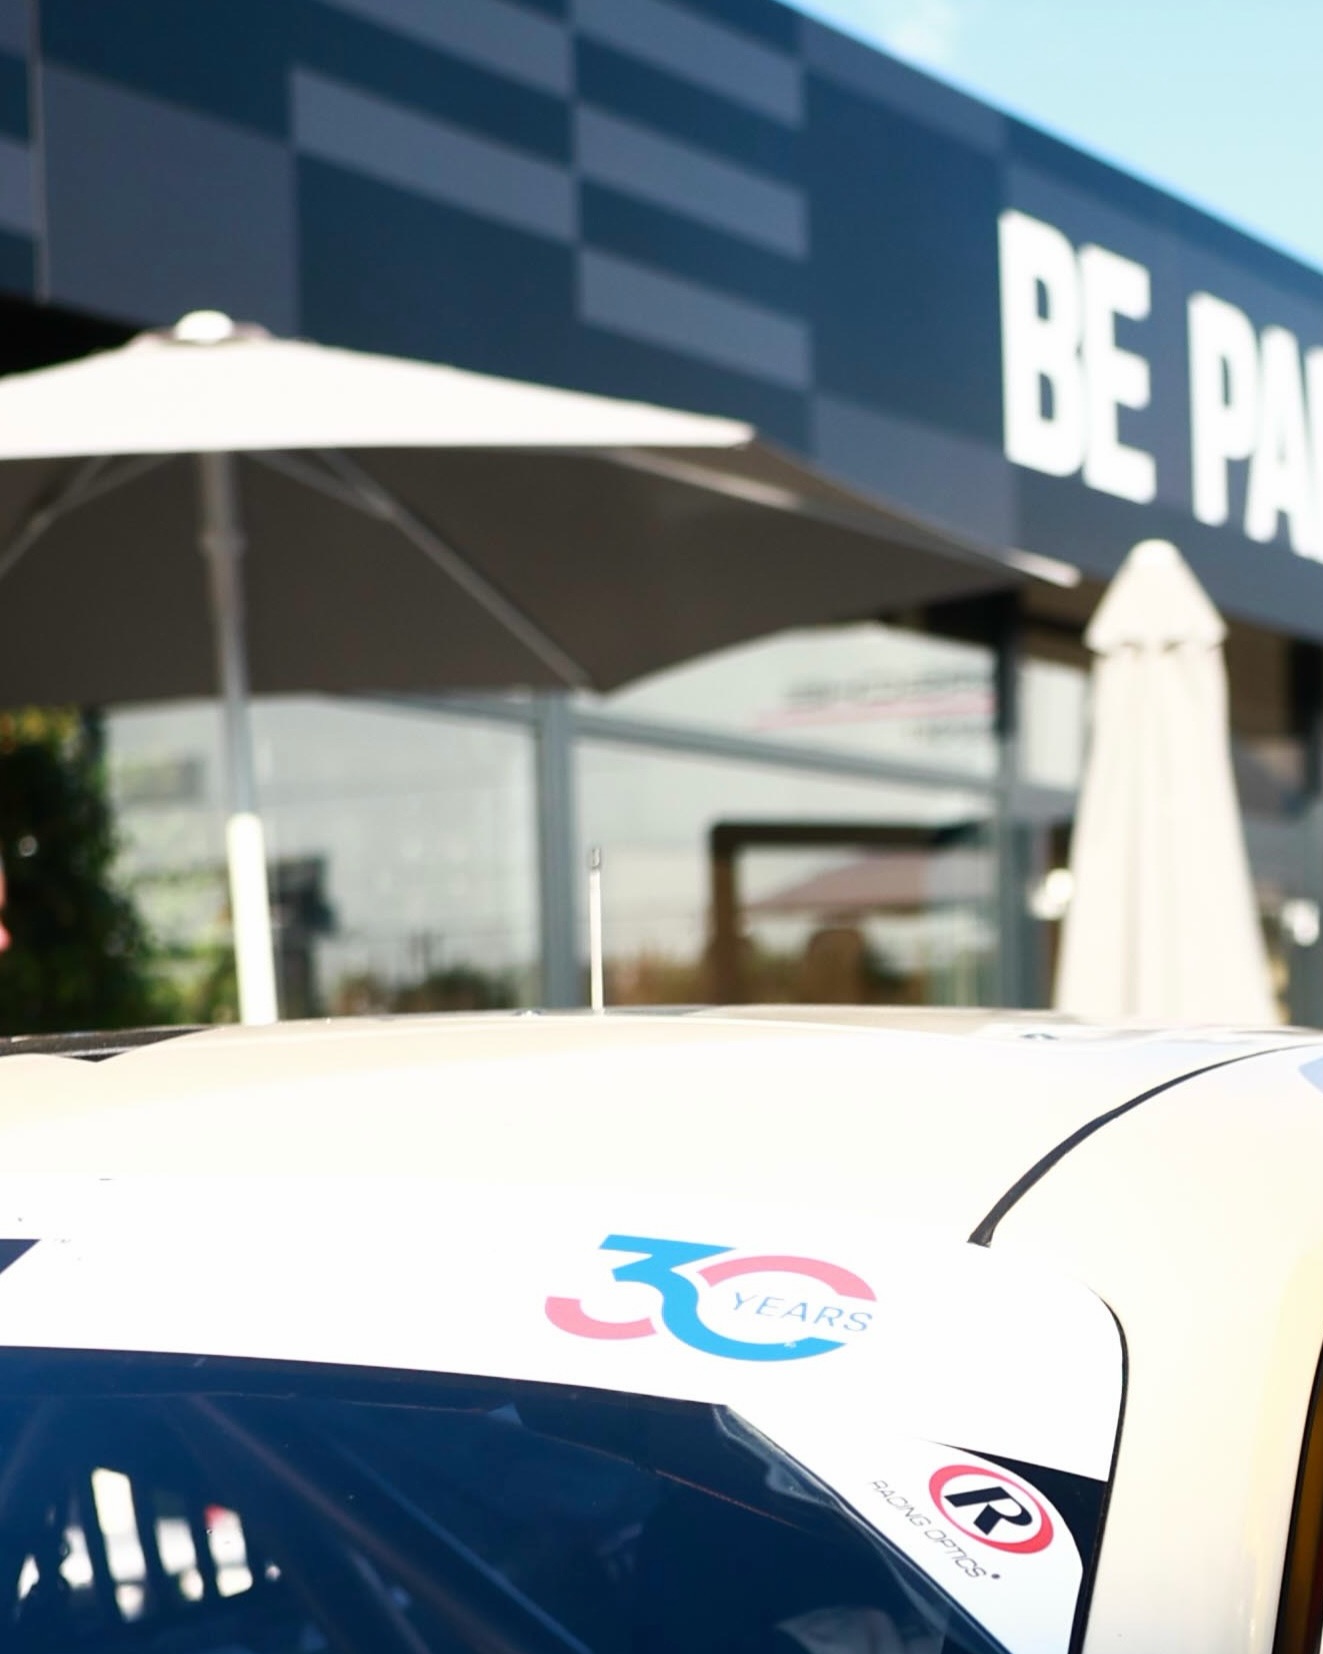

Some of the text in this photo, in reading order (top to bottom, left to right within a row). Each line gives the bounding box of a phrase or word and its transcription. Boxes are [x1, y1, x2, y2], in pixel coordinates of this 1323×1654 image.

[998, 208, 1156, 504] BE
[545, 1234, 877, 1362] 30 YEARS
[871, 1479, 988, 1579] RACING OPTICS
[943, 1485, 1033, 1536] R
